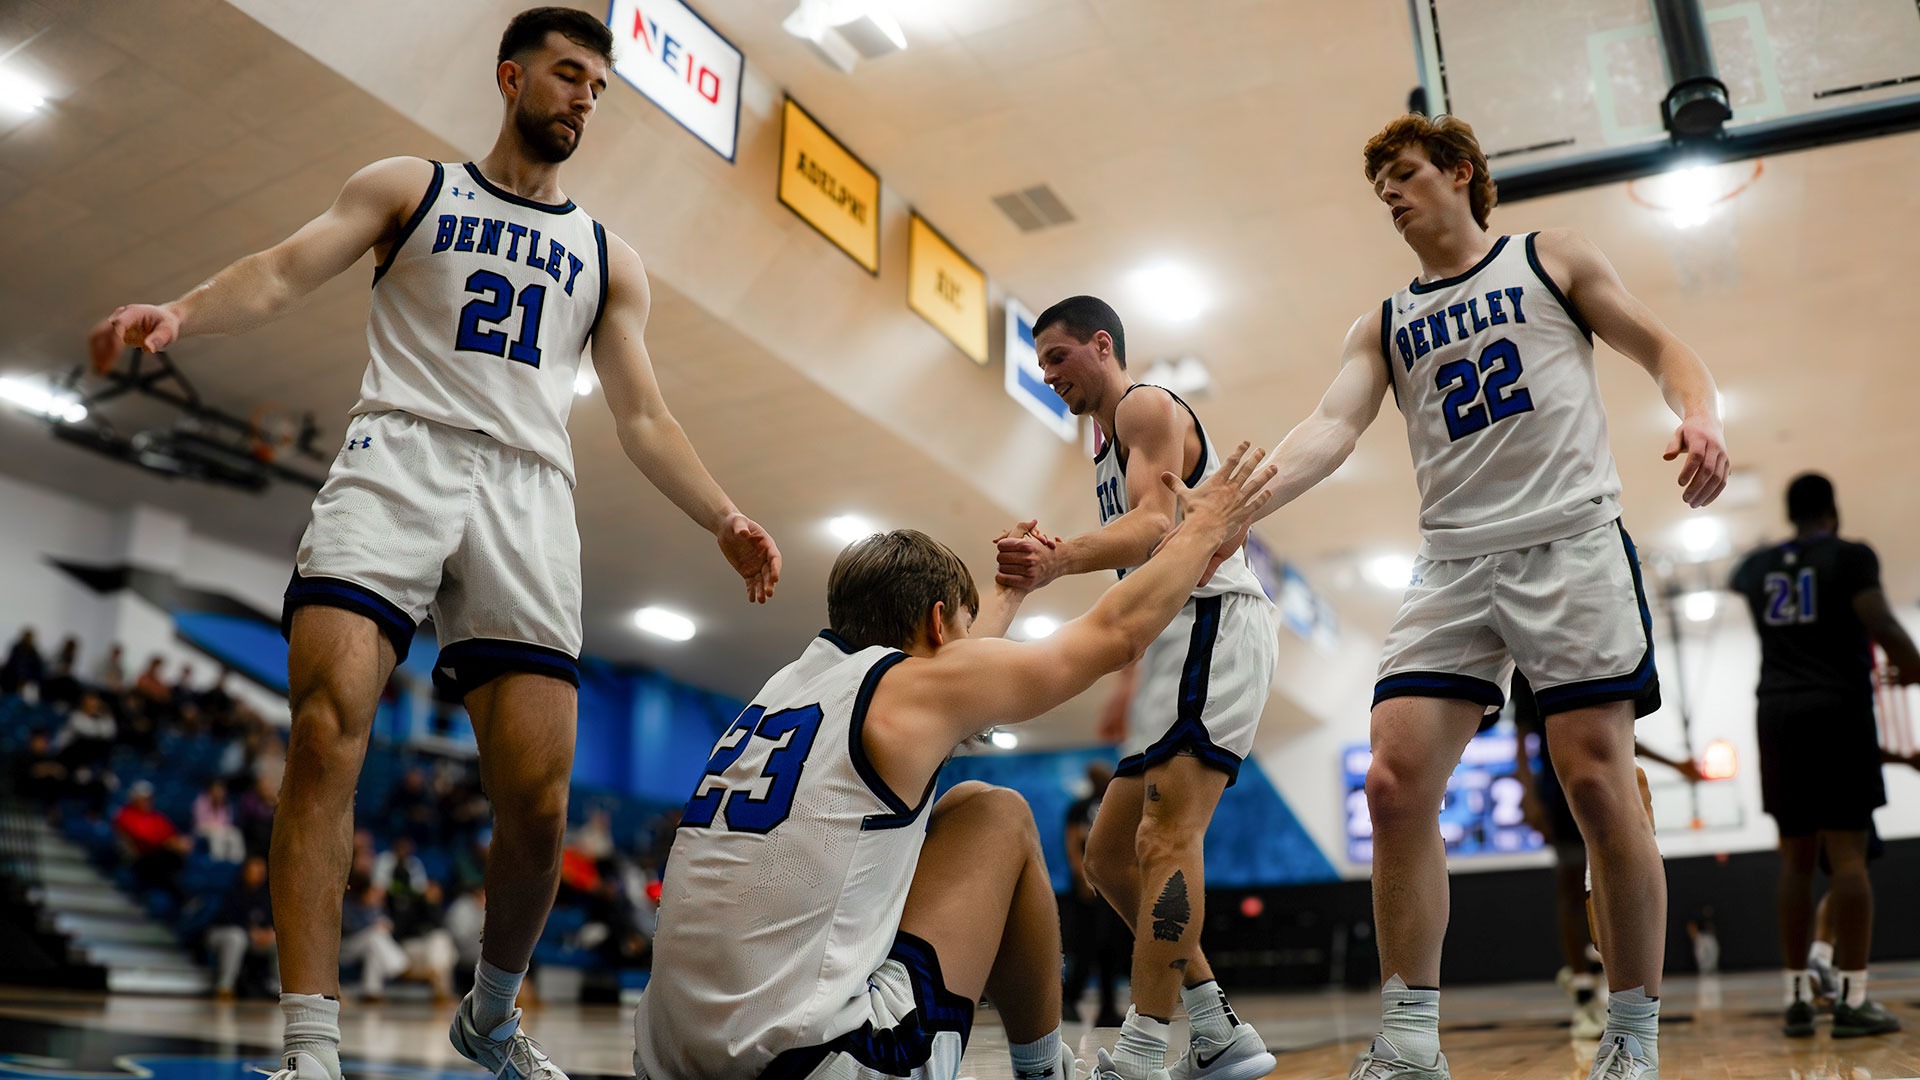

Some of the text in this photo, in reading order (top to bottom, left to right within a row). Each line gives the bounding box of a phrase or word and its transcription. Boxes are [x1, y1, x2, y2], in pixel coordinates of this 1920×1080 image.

[633, 8, 720, 104] NE10
[432, 214, 583, 297] BENTLEY
[455, 268, 547, 369] 21
[1396, 286, 1526, 373] BENTLEY
[1434, 337, 1535, 442] 22
[1763, 567, 1816, 626] 21
[679, 702, 824, 834] 23
